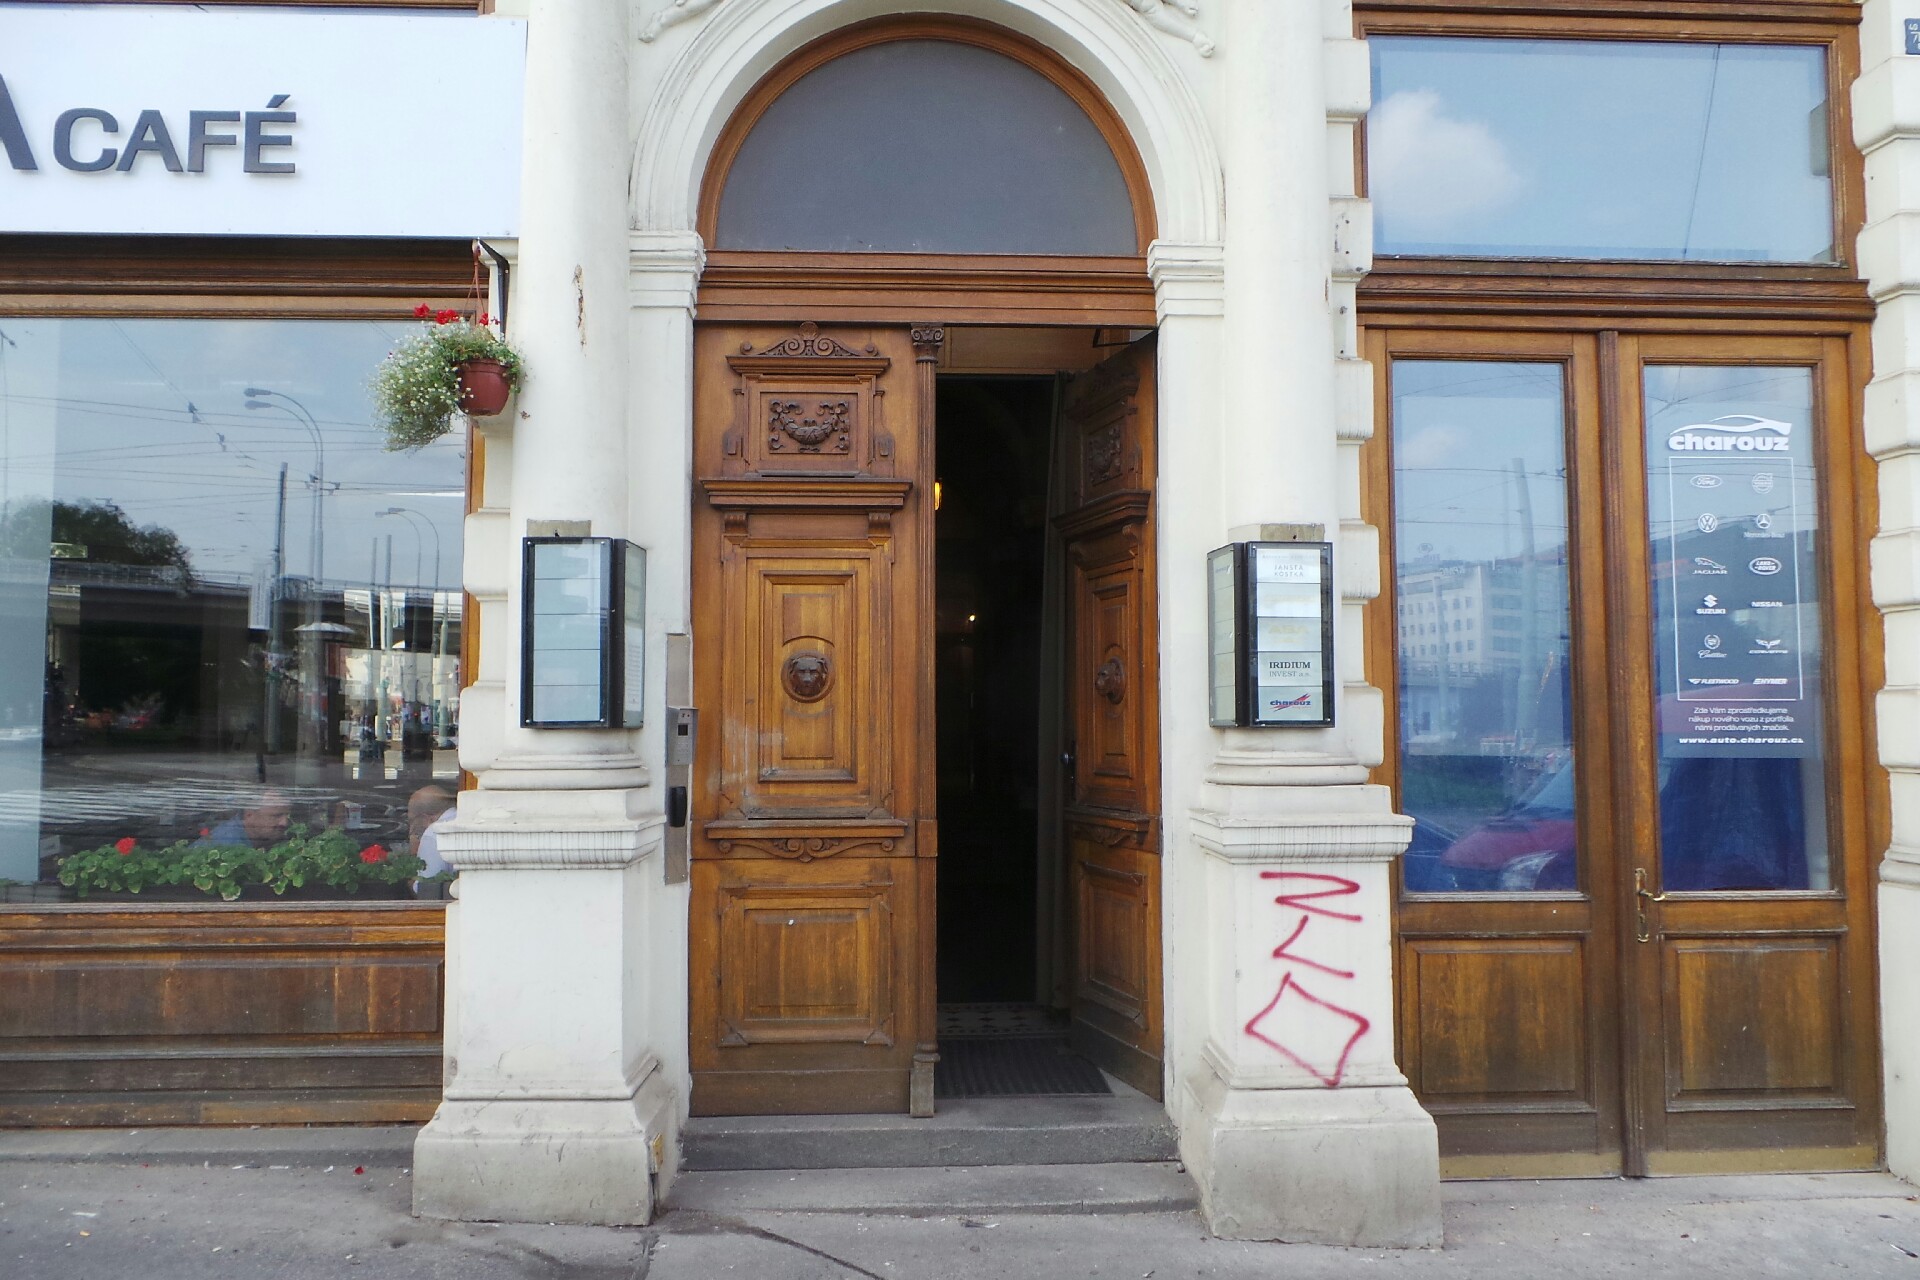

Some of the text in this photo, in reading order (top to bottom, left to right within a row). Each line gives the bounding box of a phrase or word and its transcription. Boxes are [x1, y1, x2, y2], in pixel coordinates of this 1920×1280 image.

[53, 94, 297, 173] CAFÉ
[1668, 433, 1789, 451] charouz
[1269, 661, 1311, 669] IRIDIUM
[1709, 706, 1726, 714] Vám
[1688, 715, 1711, 724] nákup
[1711, 715, 1739, 723] nového
